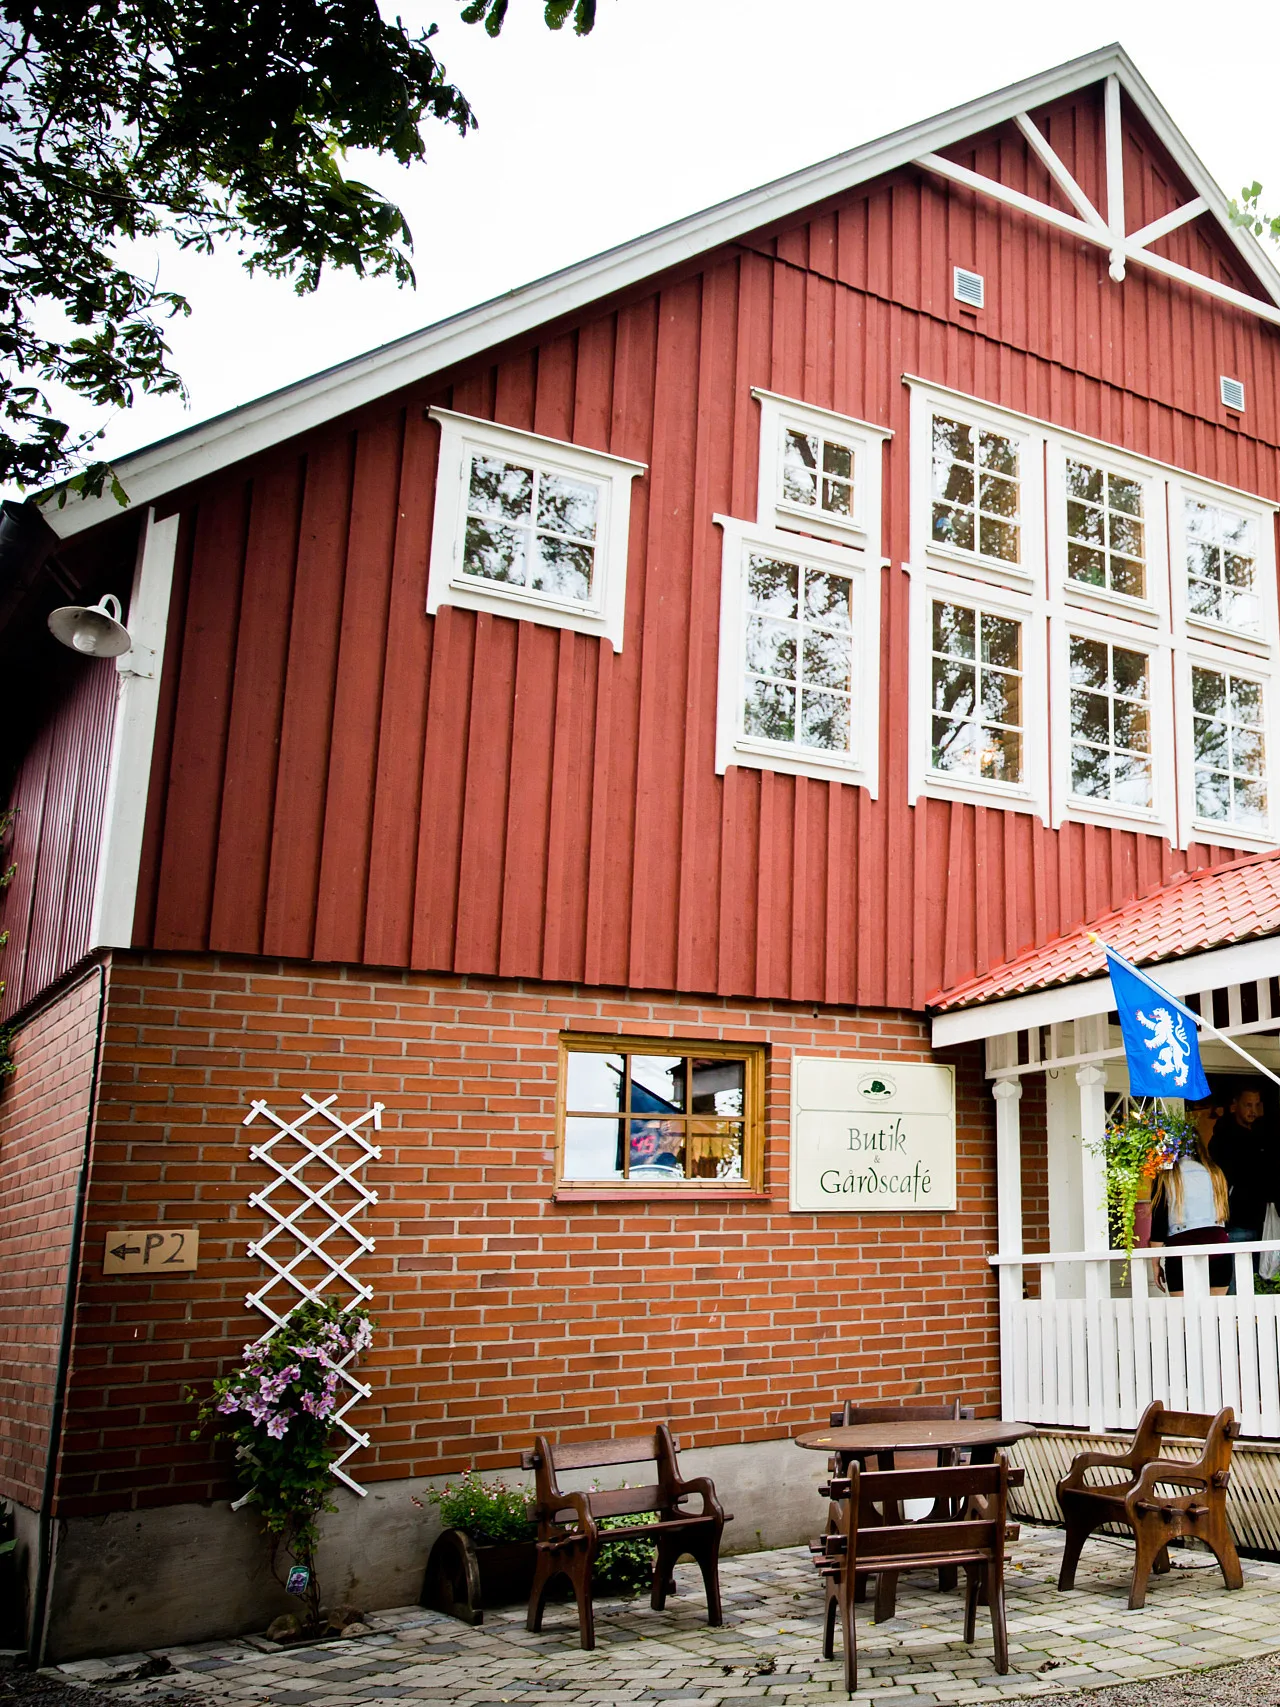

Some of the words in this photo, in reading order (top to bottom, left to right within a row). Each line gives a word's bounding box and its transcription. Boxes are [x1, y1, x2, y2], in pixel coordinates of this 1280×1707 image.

[847, 1118, 907, 1155] Butik
[873, 1155, 881, 1164] &
[820, 1160, 932, 1203] Gårdscafé
[143, 1233, 185, 1265] P2
